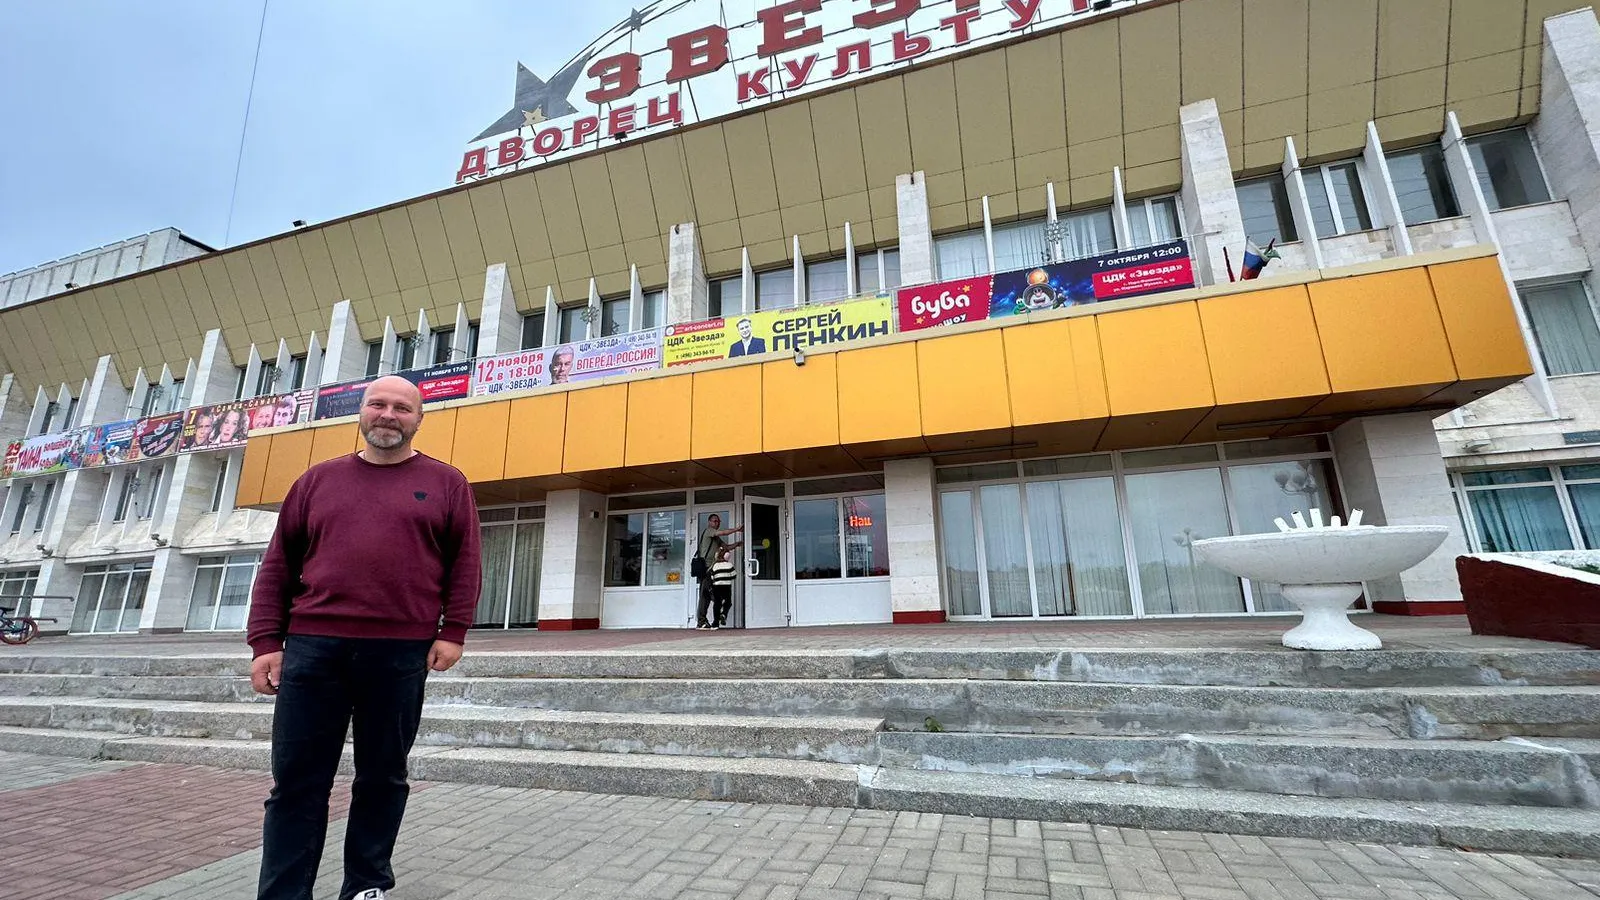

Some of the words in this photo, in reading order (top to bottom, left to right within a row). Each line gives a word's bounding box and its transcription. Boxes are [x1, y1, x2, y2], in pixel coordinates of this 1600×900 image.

[455, 91, 684, 184] ДВОРЕЦ
[1107, 252, 1150, 266] ОКТЯБРЯ
[1152, 246, 1182, 258] 12:00
[1102, 272, 1127, 283] ЦДК
[1129, 264, 1183, 278] «Звезда»
[684, 321, 724, 331] art-concert.ru
[772, 308, 842, 334] СЕРГЕЙ
[667, 336, 685, 347] ЦДК
[687, 332, 725, 343] «Звезда»
[772, 320, 889, 352] ПЕНКИН
[579, 343, 592, 352] ЦДК
[452, 365, 468, 373] 17:00
[477, 359, 495, 383] 12
[497, 352, 544, 368] ноября
[497, 373, 504, 381] в
[509, 364, 543, 379] 18:00
[488, 383, 504, 394] ЦДК
[505, 377, 542, 390] «ЗВЕЗДА»
[189, 409, 198, 425] 7
